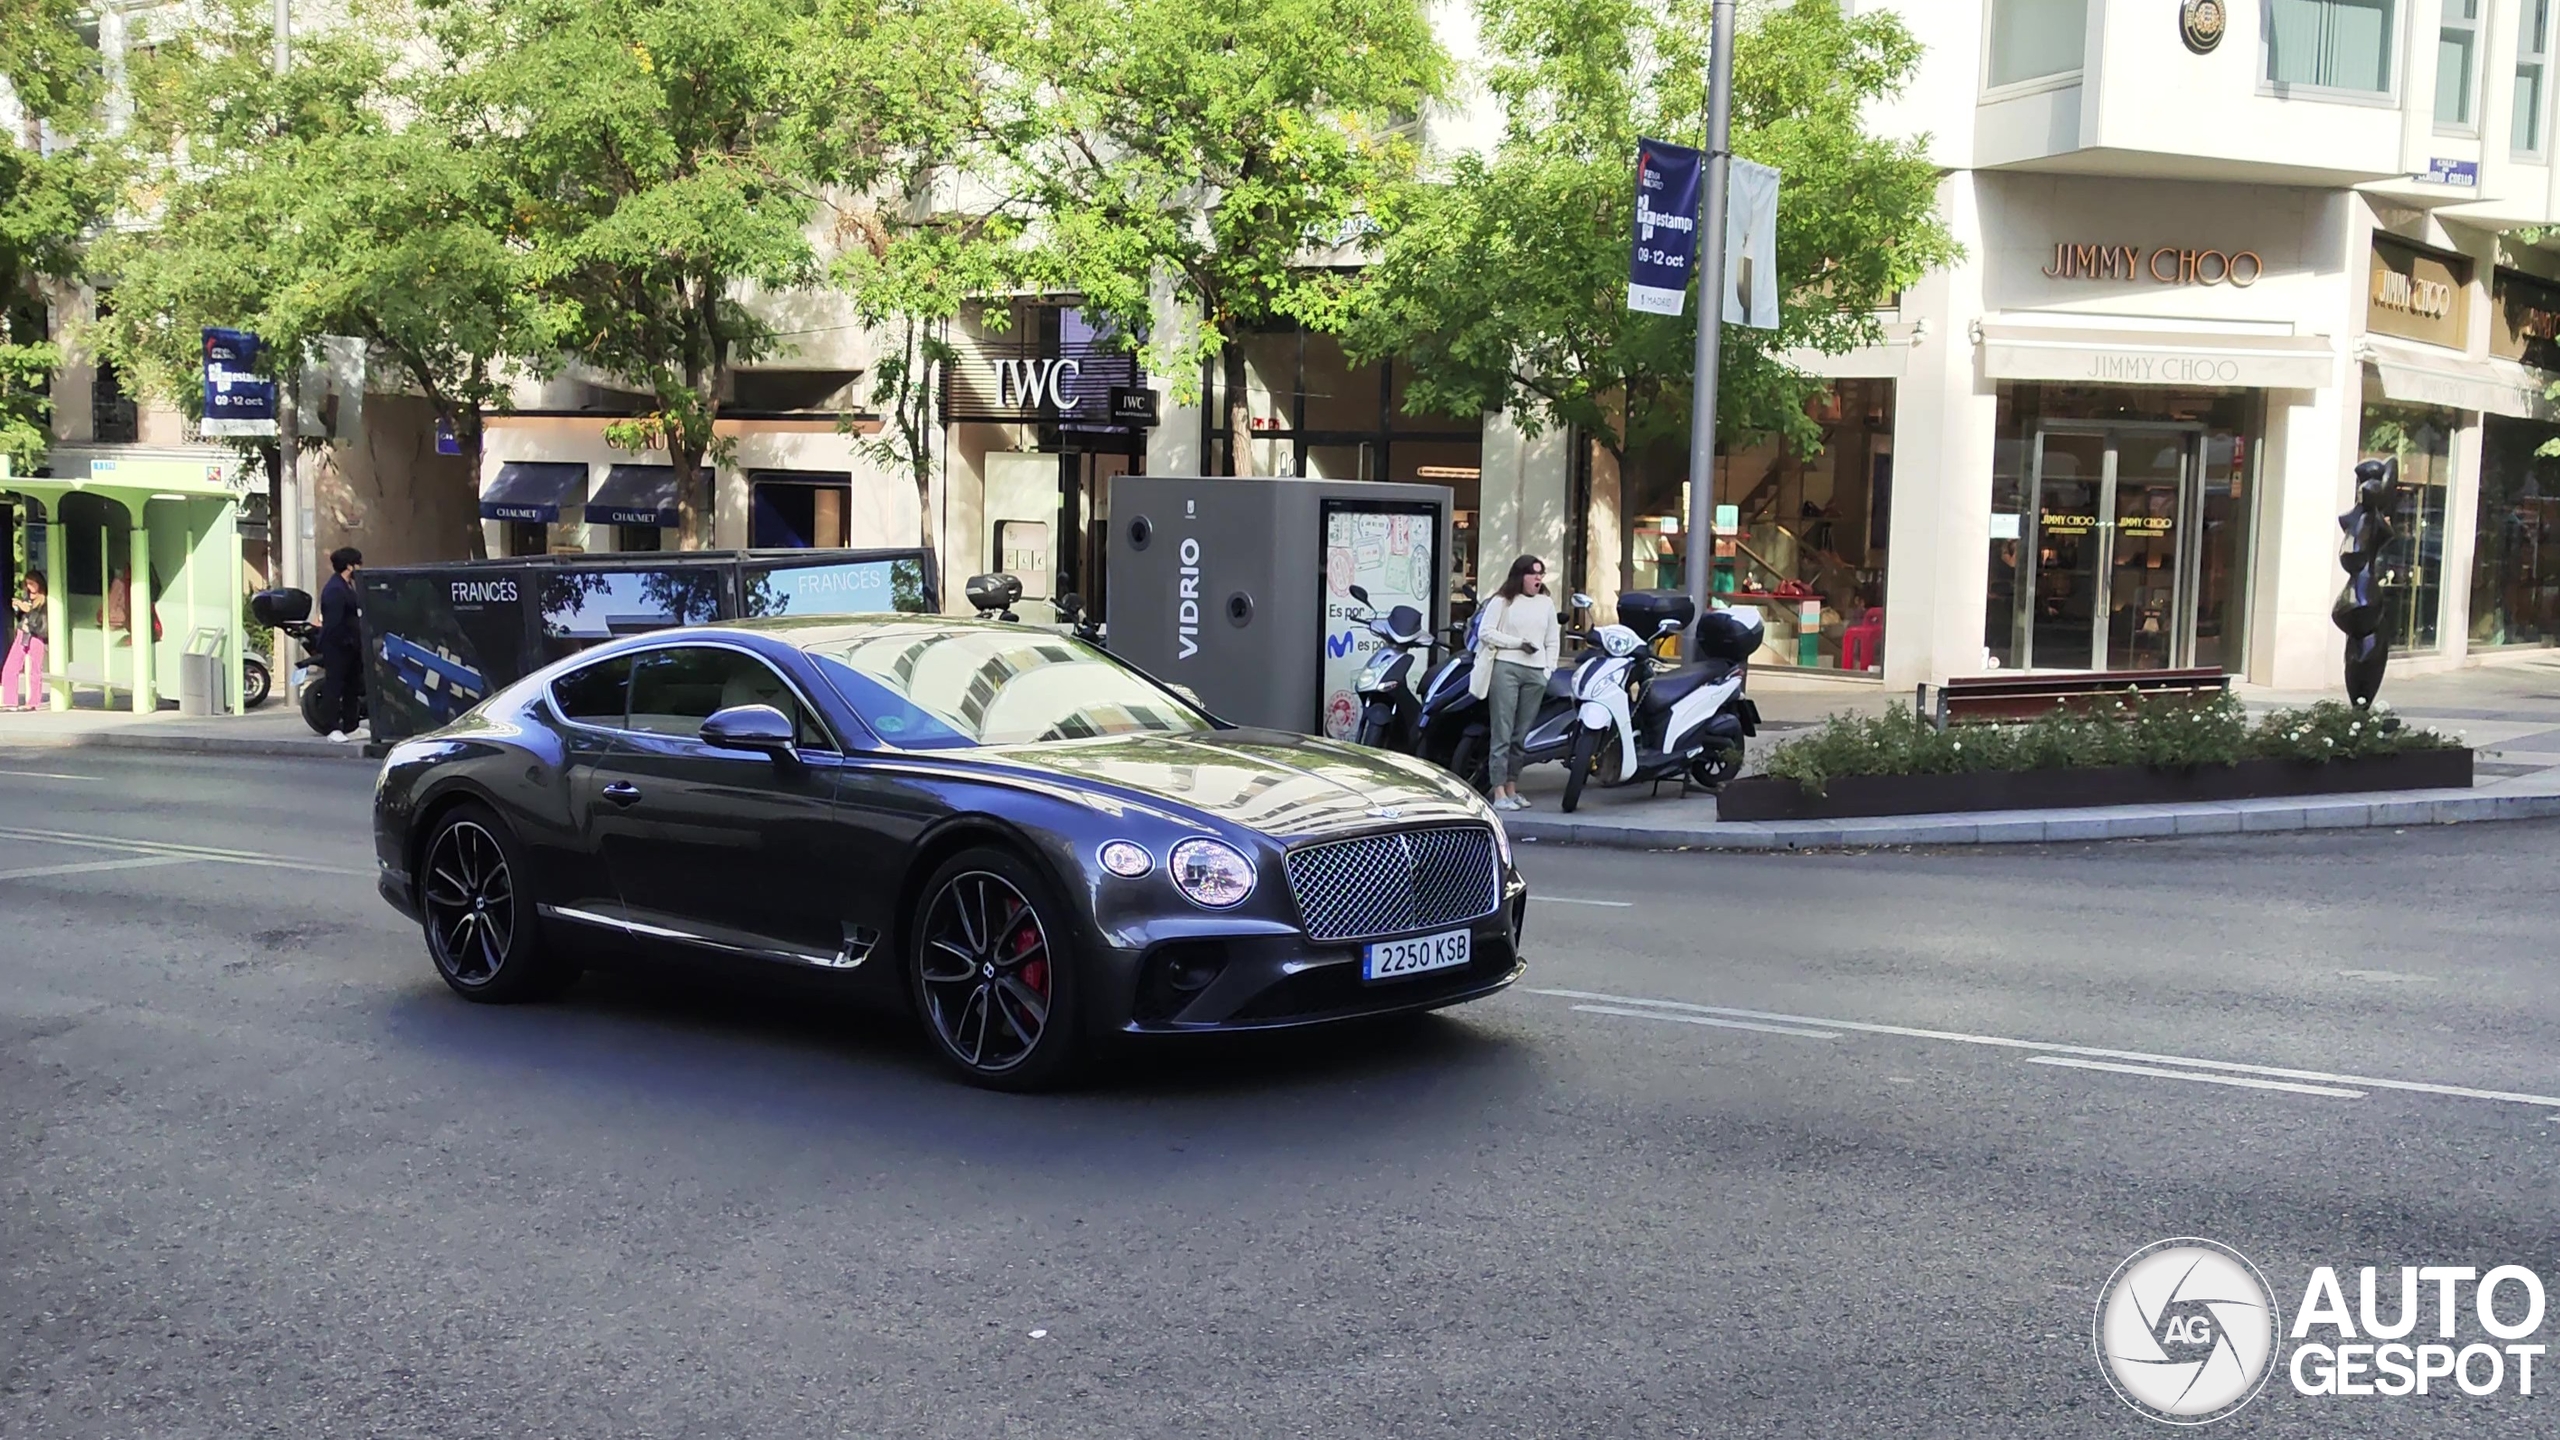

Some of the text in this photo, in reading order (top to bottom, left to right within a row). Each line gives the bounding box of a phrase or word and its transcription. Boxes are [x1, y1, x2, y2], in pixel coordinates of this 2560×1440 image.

[1666, 255, 1684, 268] oct
[2043, 243, 2264, 288] JIMMY CHOO
[2376, 270, 2450, 317] JIMMY CHOO
[2087, 356, 2239, 382] JIMMY CHOO
[992, 359, 1080, 410] IWC
[244, 397, 264, 406] oct
[1123, 395, 1145, 410] IWC
[496, 507, 538, 519] CHAUMET
[612, 511, 657, 523] CHAUMET
[2041, 514, 2096, 526] JIMMY CHOO
[2118, 517, 2172, 529] JIMMY CHOO
[451, 577, 518, 602] FRANCÉS
[798, 567, 881, 595] FRANCÉS
[1178, 537, 1200, 660] VIDRIO
[1329, 603, 1343, 618] Es
[1344, 606, 1365, 621] por
[1357, 639, 1386, 653] es po
[1380, 934, 1467, 973] 2250 KSB
